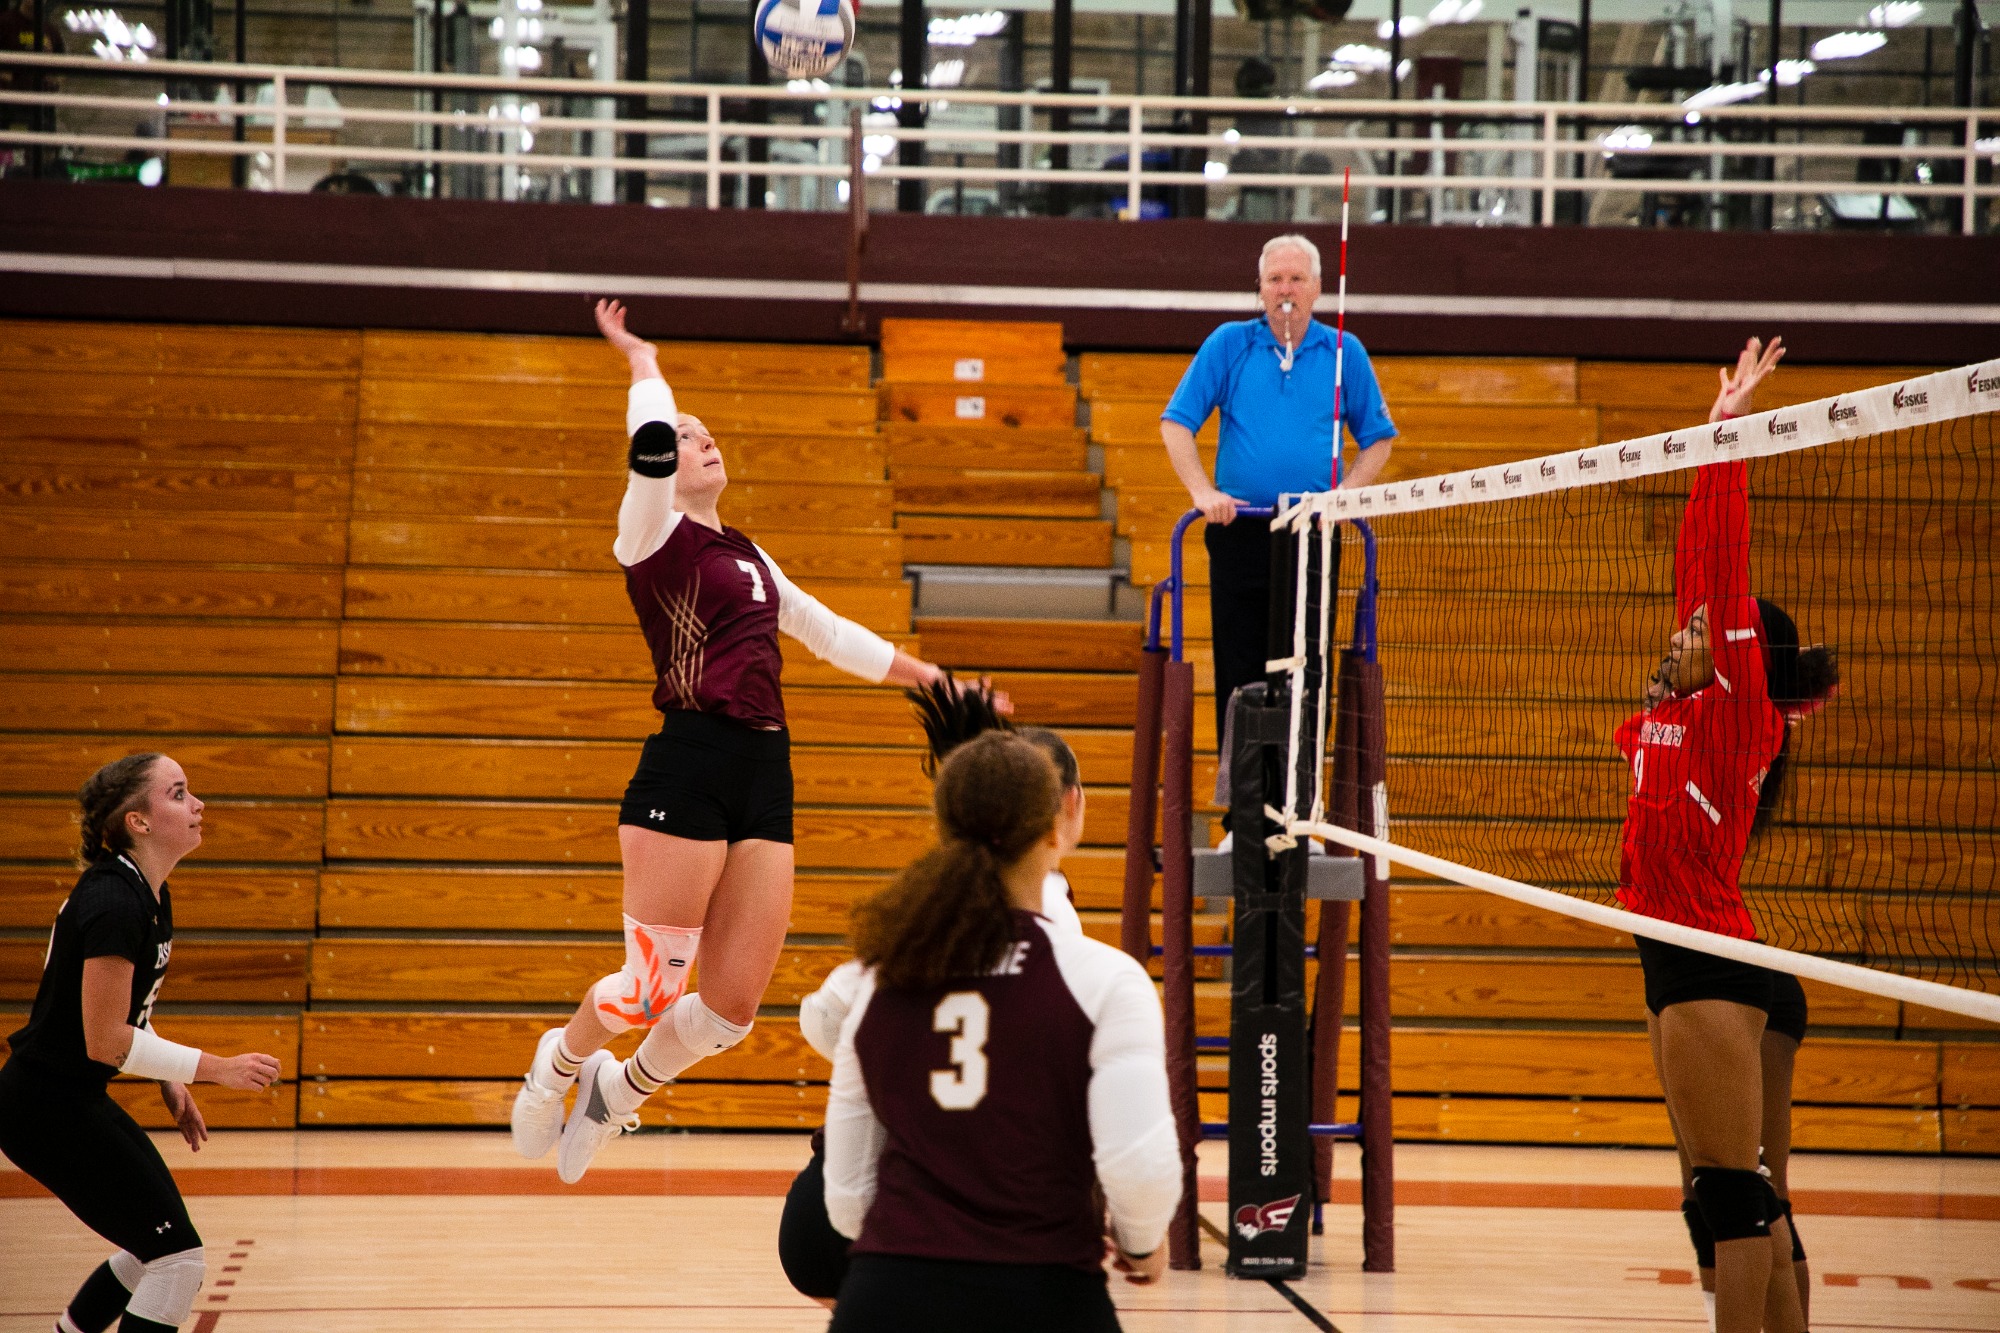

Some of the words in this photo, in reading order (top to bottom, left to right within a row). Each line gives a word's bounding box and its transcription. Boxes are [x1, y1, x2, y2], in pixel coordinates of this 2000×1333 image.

[735, 559, 767, 603] 7
[929, 990, 991, 1111] 3
[1258, 1033, 1279, 1096] sports
[1257, 1098, 1279, 1177] imports
